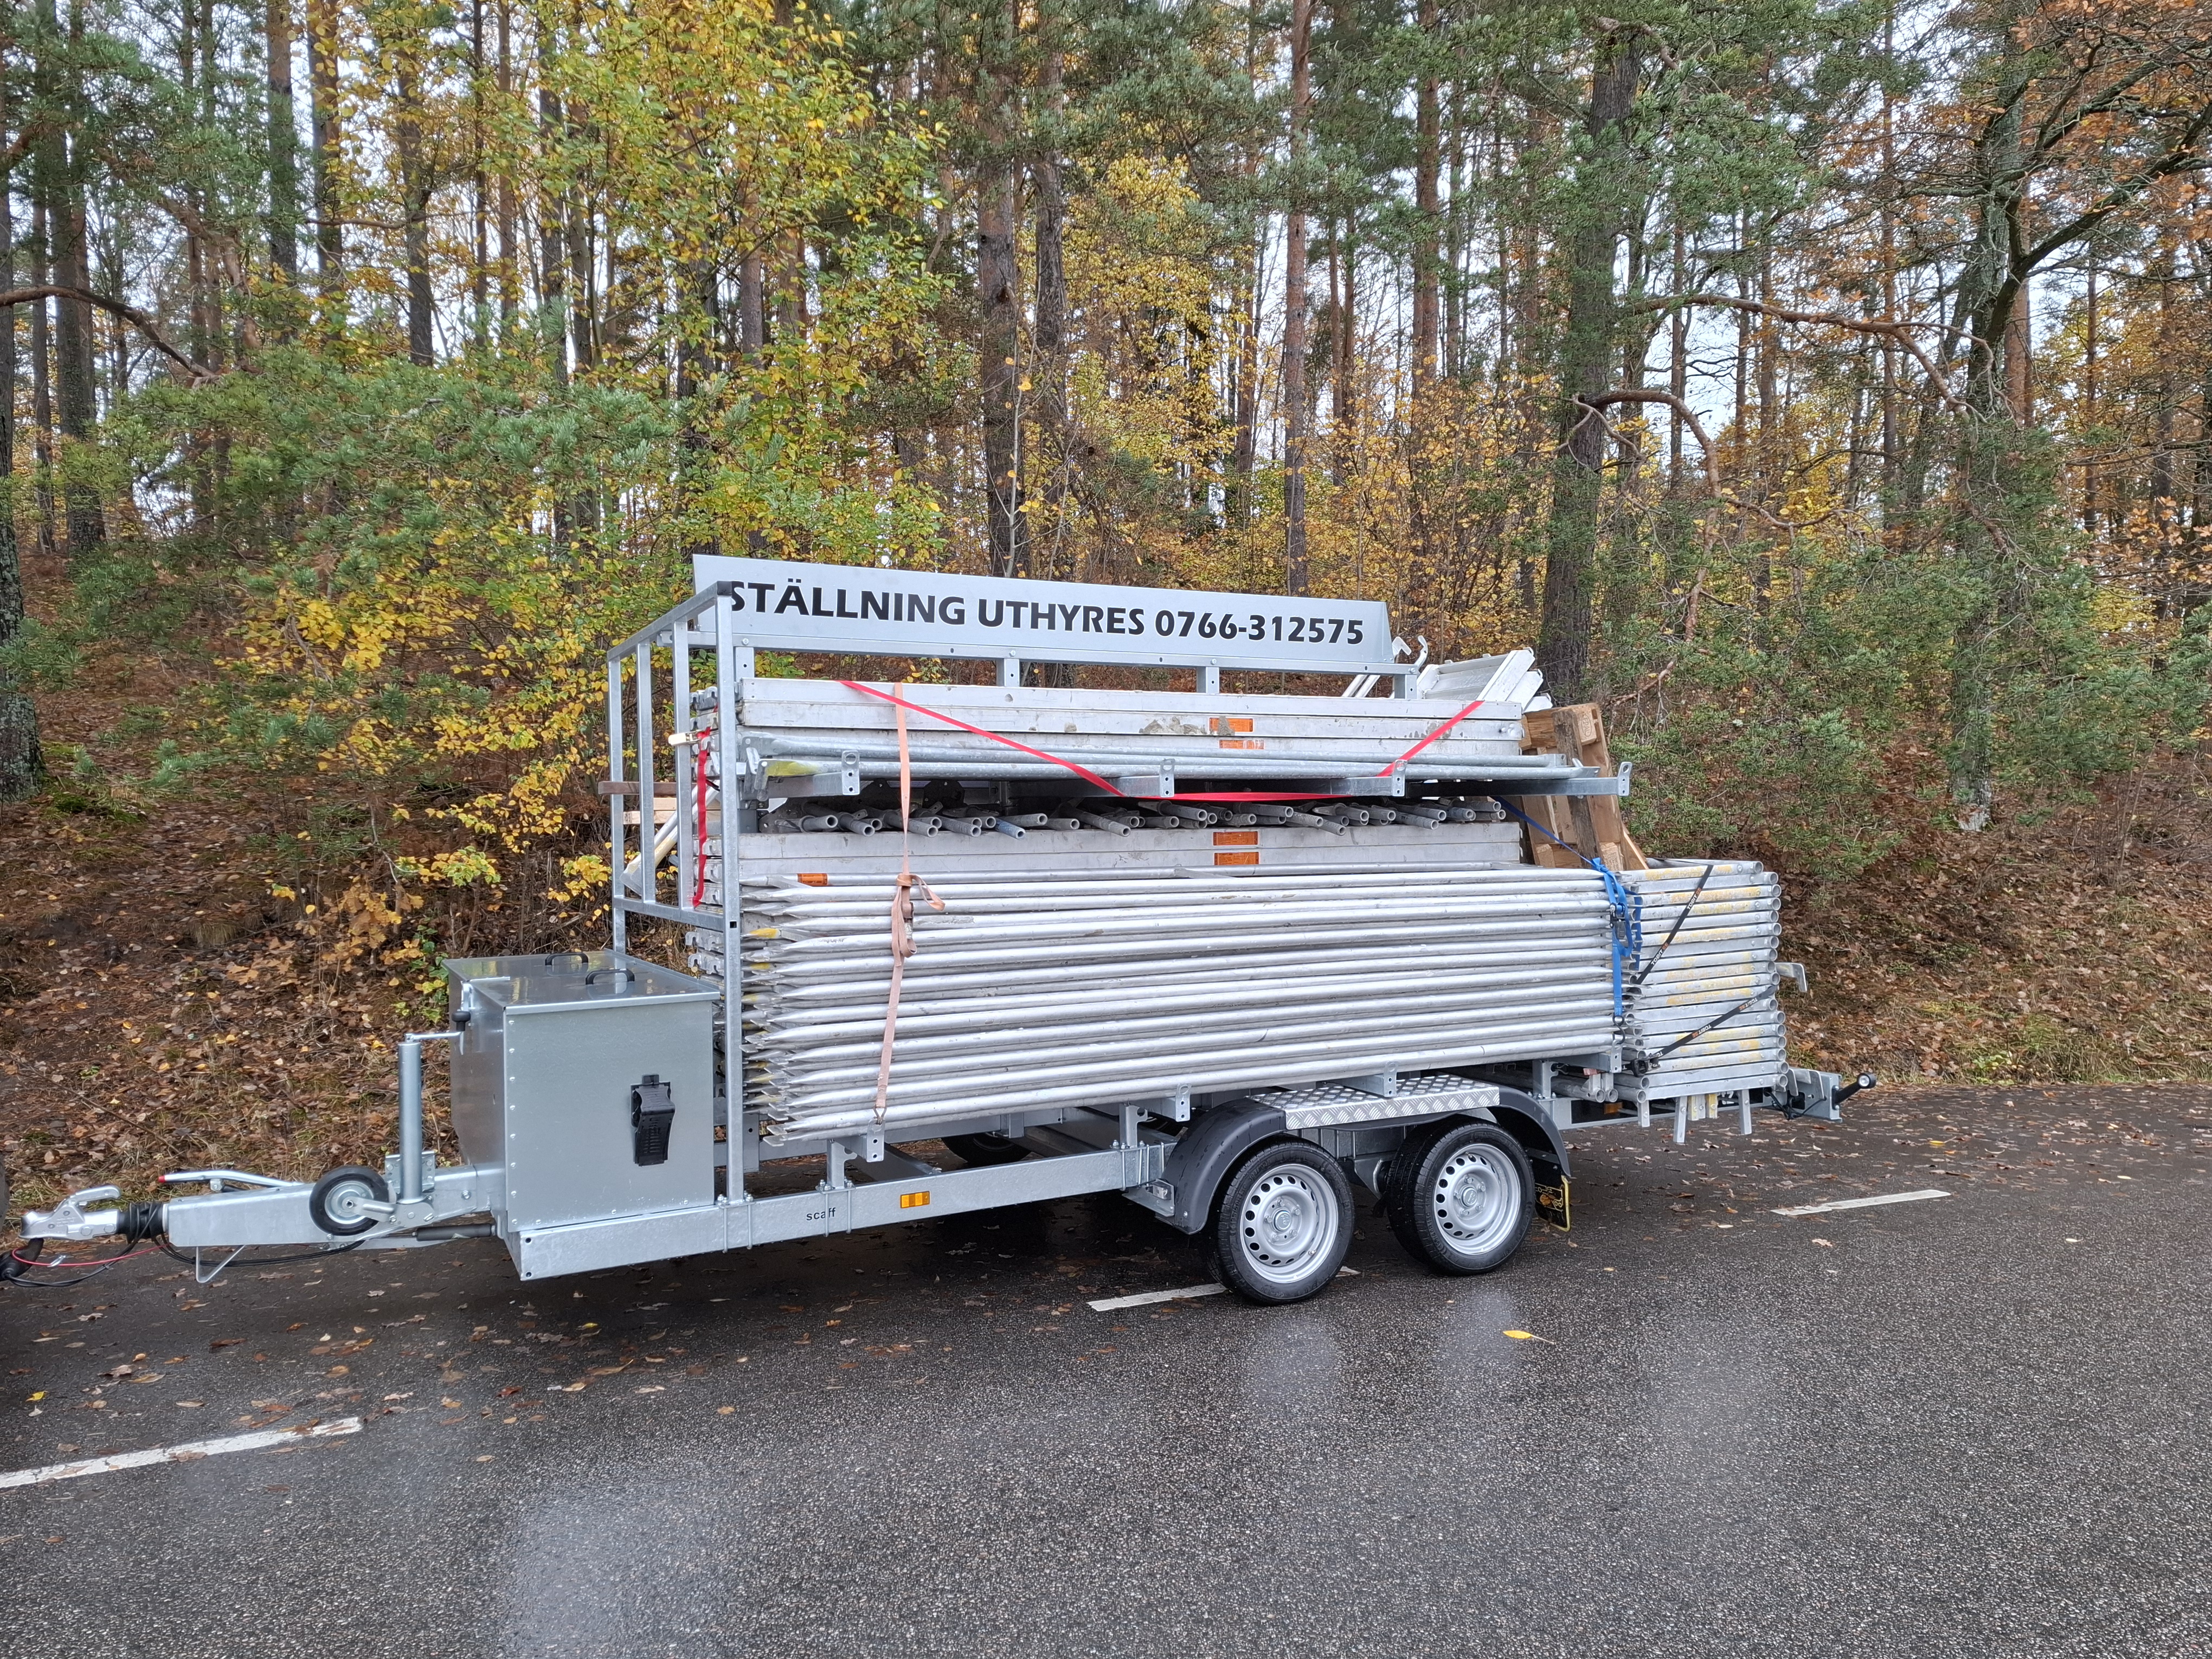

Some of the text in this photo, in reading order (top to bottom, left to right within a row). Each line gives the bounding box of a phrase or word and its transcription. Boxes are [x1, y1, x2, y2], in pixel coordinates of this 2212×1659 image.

[731, 577, 1363, 645] STÄLLNING UTHYRES 0766-312575
[806, 1207, 836, 1221] scaff
